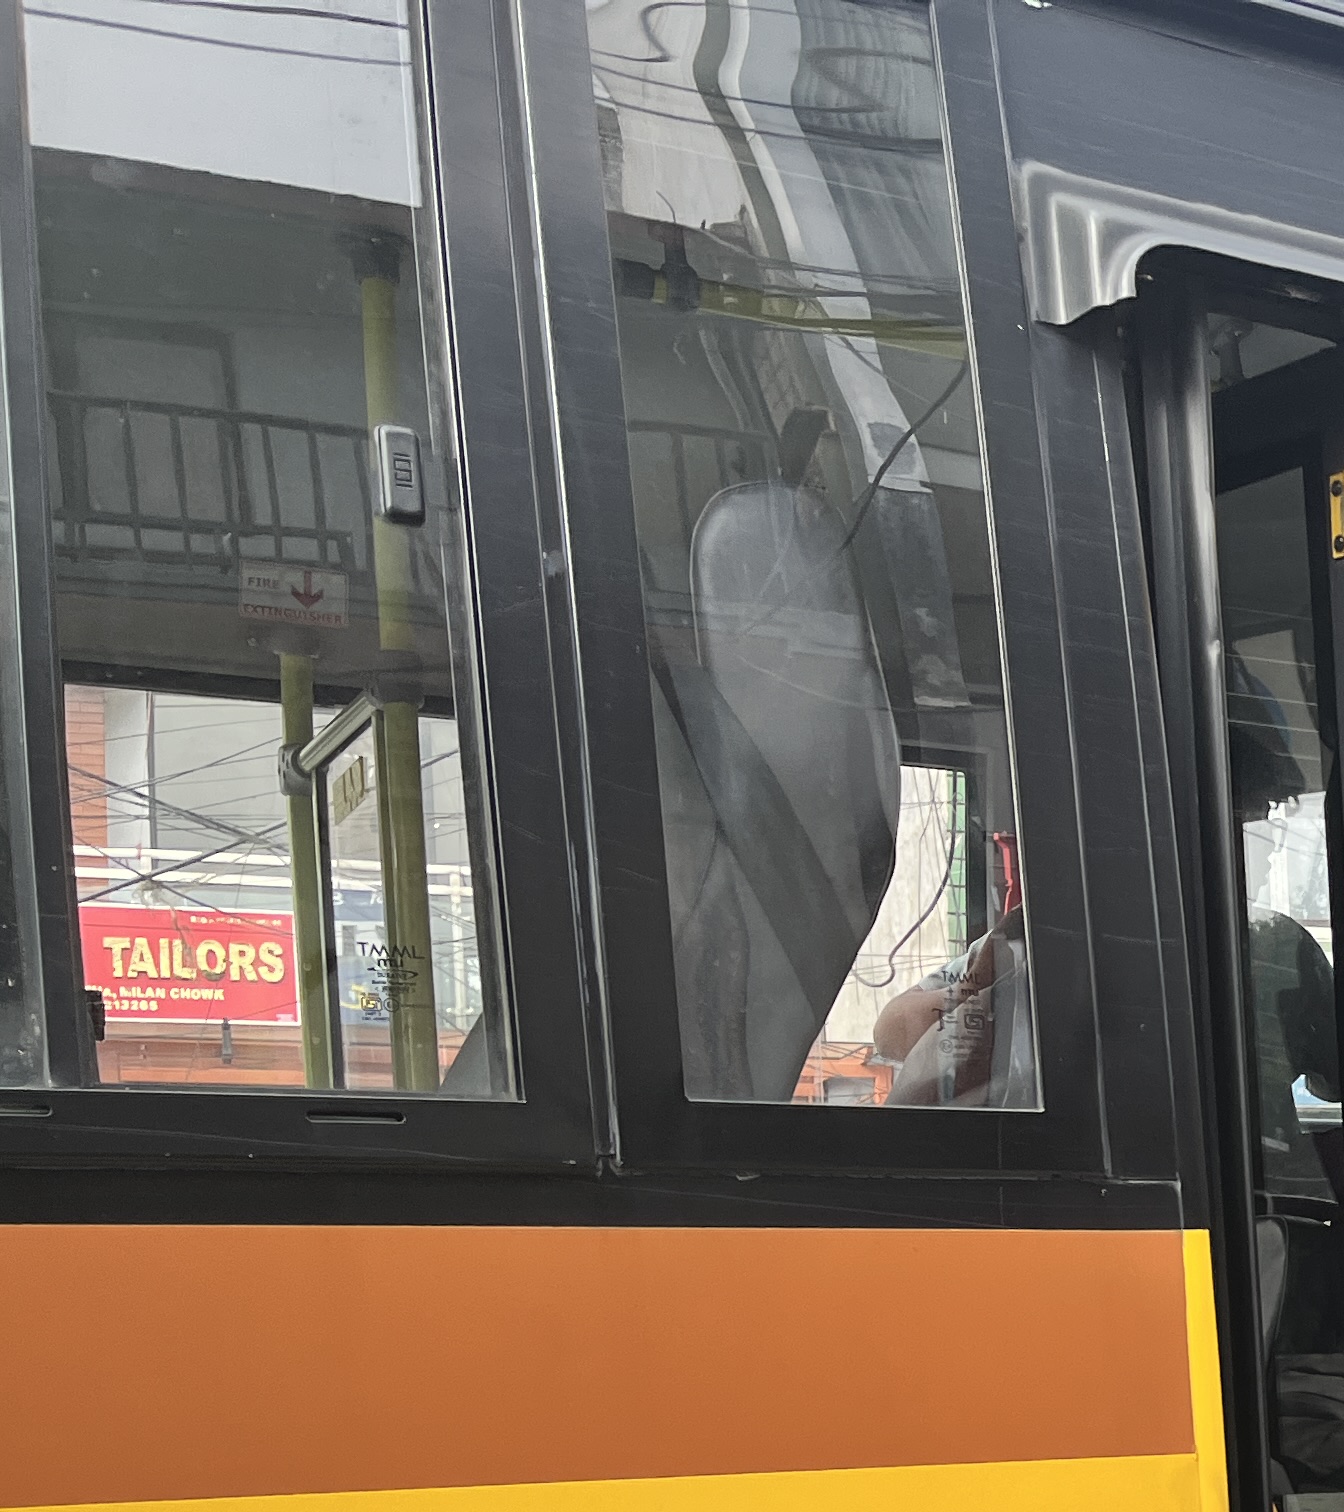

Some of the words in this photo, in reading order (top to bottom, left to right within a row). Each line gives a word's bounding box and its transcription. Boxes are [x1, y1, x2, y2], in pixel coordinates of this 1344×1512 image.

[248, 577, 281, 588] FIRE
[243, 604, 342, 624] EXTINGUISHER
[103, 937, 285, 983] TAILORS
[120, 986, 166, 999] MILAN
[170, 987, 224, 1000] CHOWK
